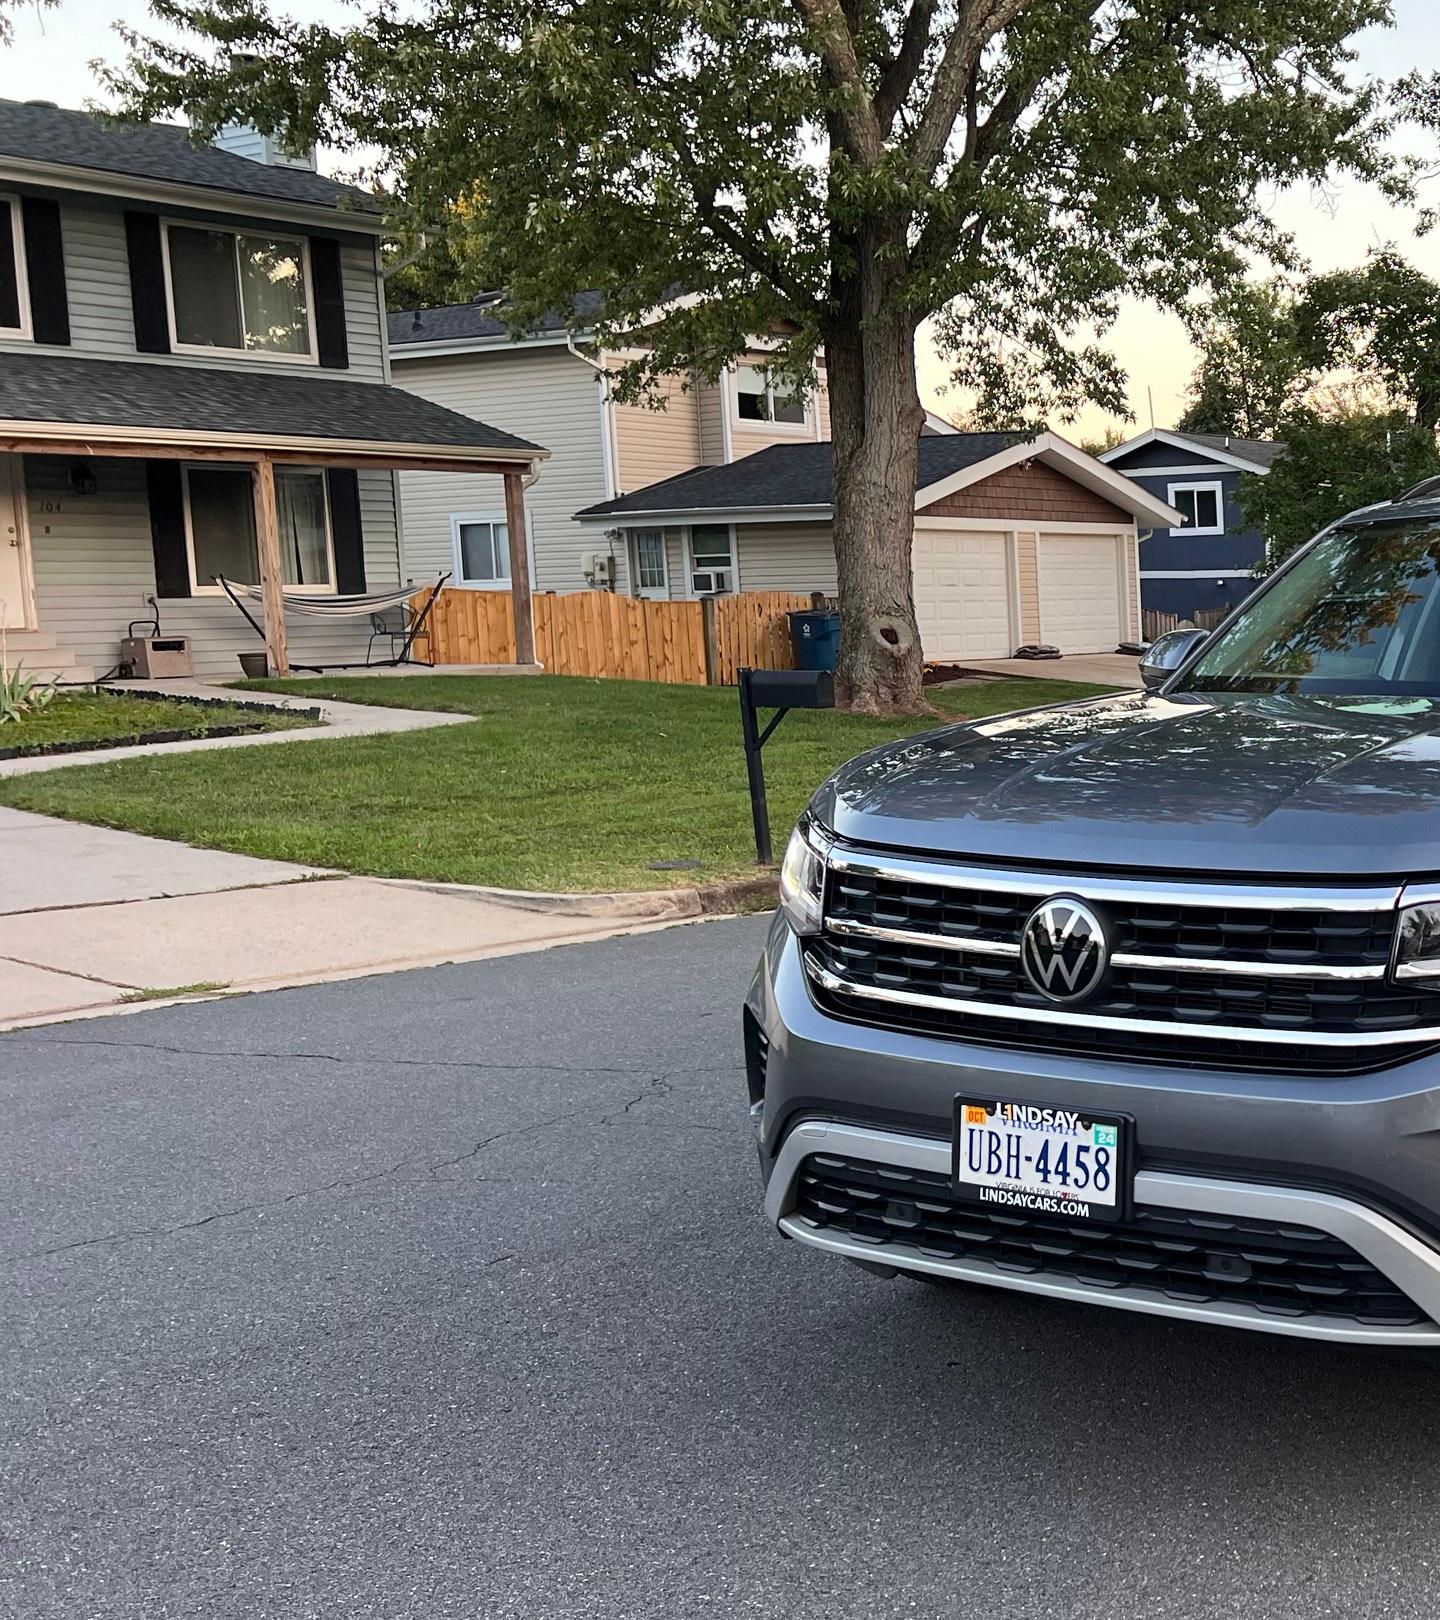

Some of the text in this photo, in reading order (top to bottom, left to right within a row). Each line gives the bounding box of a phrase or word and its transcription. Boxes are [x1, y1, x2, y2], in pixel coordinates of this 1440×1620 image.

[969, 1110, 984, 1123] OCT
[1098, 1133, 1114, 1144] 24
[968, 1128, 1110, 1192] UBH-4458
[979, 1187, 1090, 1218] LINDSAYCARS.COM
